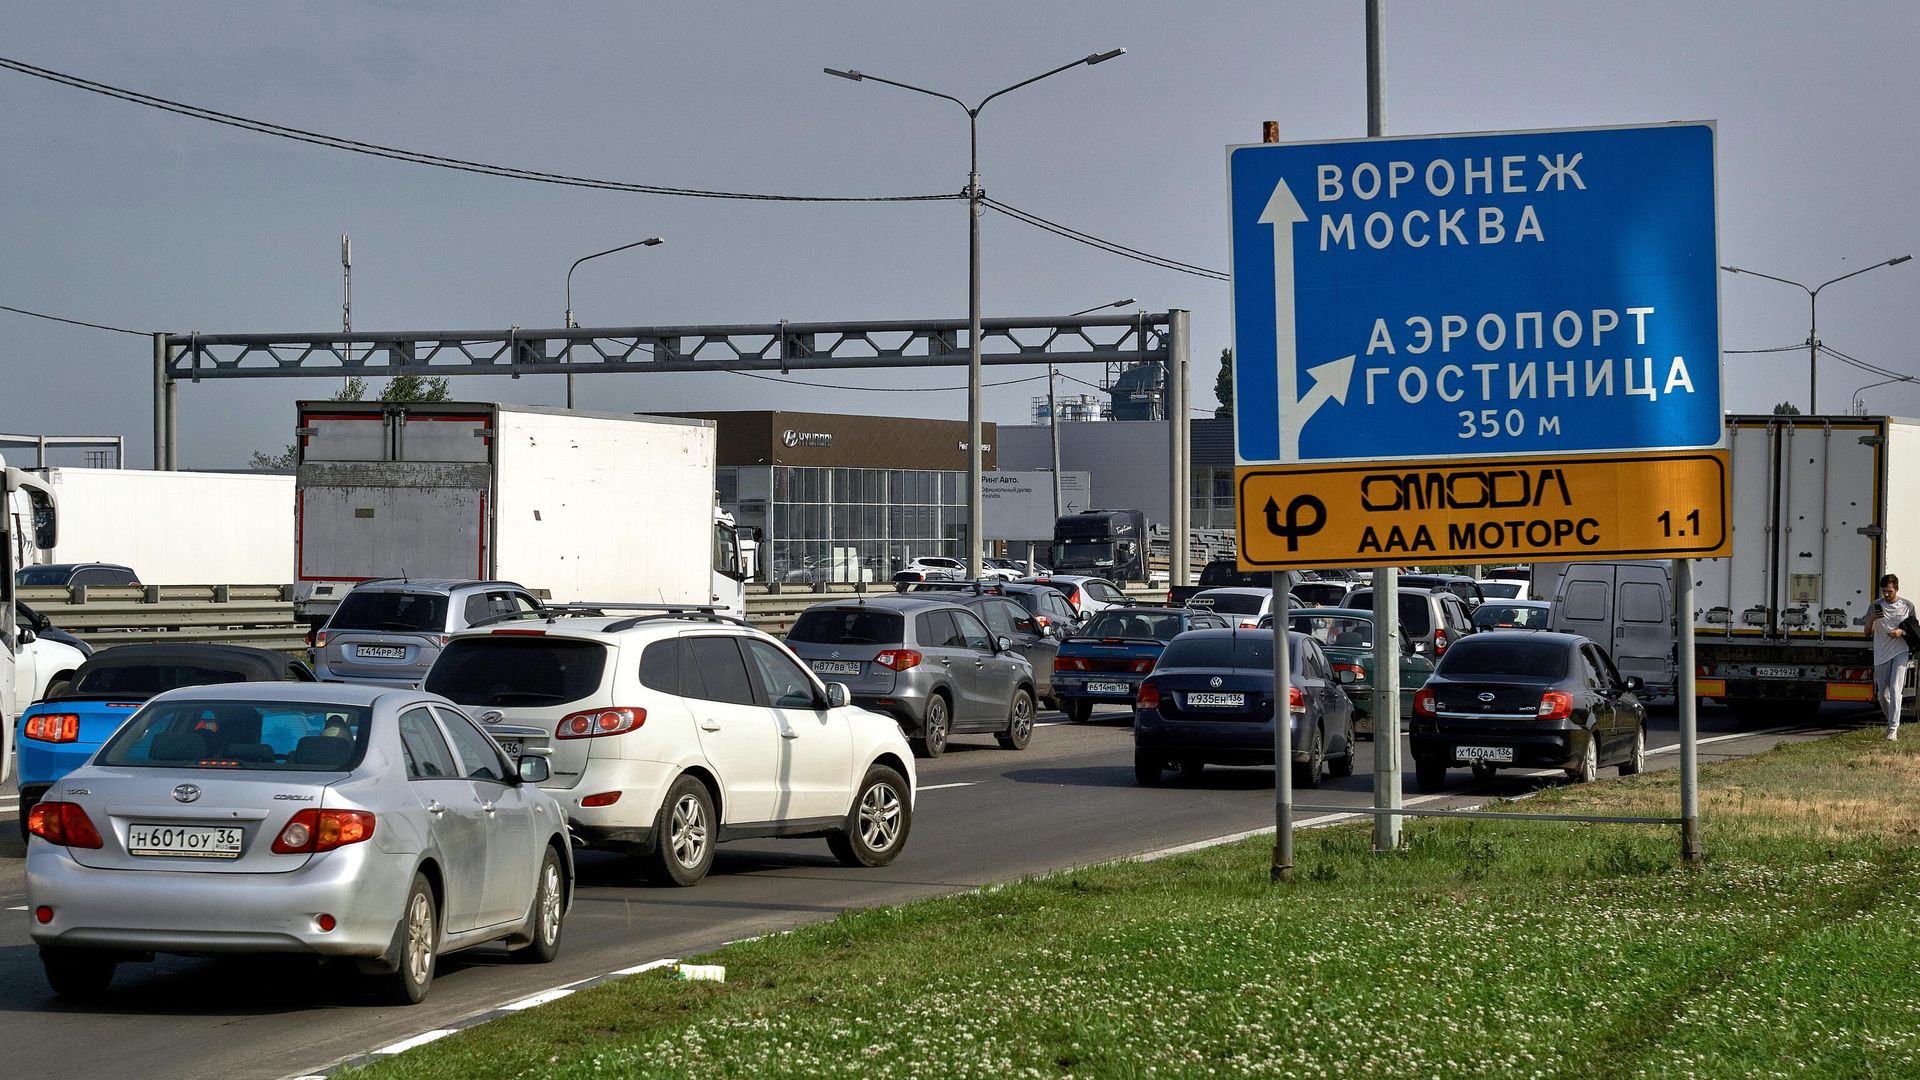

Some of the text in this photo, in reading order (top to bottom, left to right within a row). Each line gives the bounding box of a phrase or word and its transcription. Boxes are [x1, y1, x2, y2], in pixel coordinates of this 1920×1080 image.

[1317, 152, 1587, 202] ВОРОНЕЖ
[1319, 205, 1545, 252] МОСКВА
[1366, 306, 1655, 356] АЭРОПОРТ
[1366, 356, 1695, 405] ГОСТИНИЦА
[1458, 409, 1525, 439] 350
[981, 476, 997, 484] Ринг
[1360, 468, 1572, 512] OMODA
[1357, 517, 1601, 554] ААА МОТОРС
[1657, 508, 1701, 538] 1.1
[814, 661, 859, 671] Н877ВВ 136
[1190, 694, 1243, 704] У935ЕН 136
[1459, 747, 1511, 758] Х160АА 136
[136, 828, 235, 849] Н601ОУ 36
